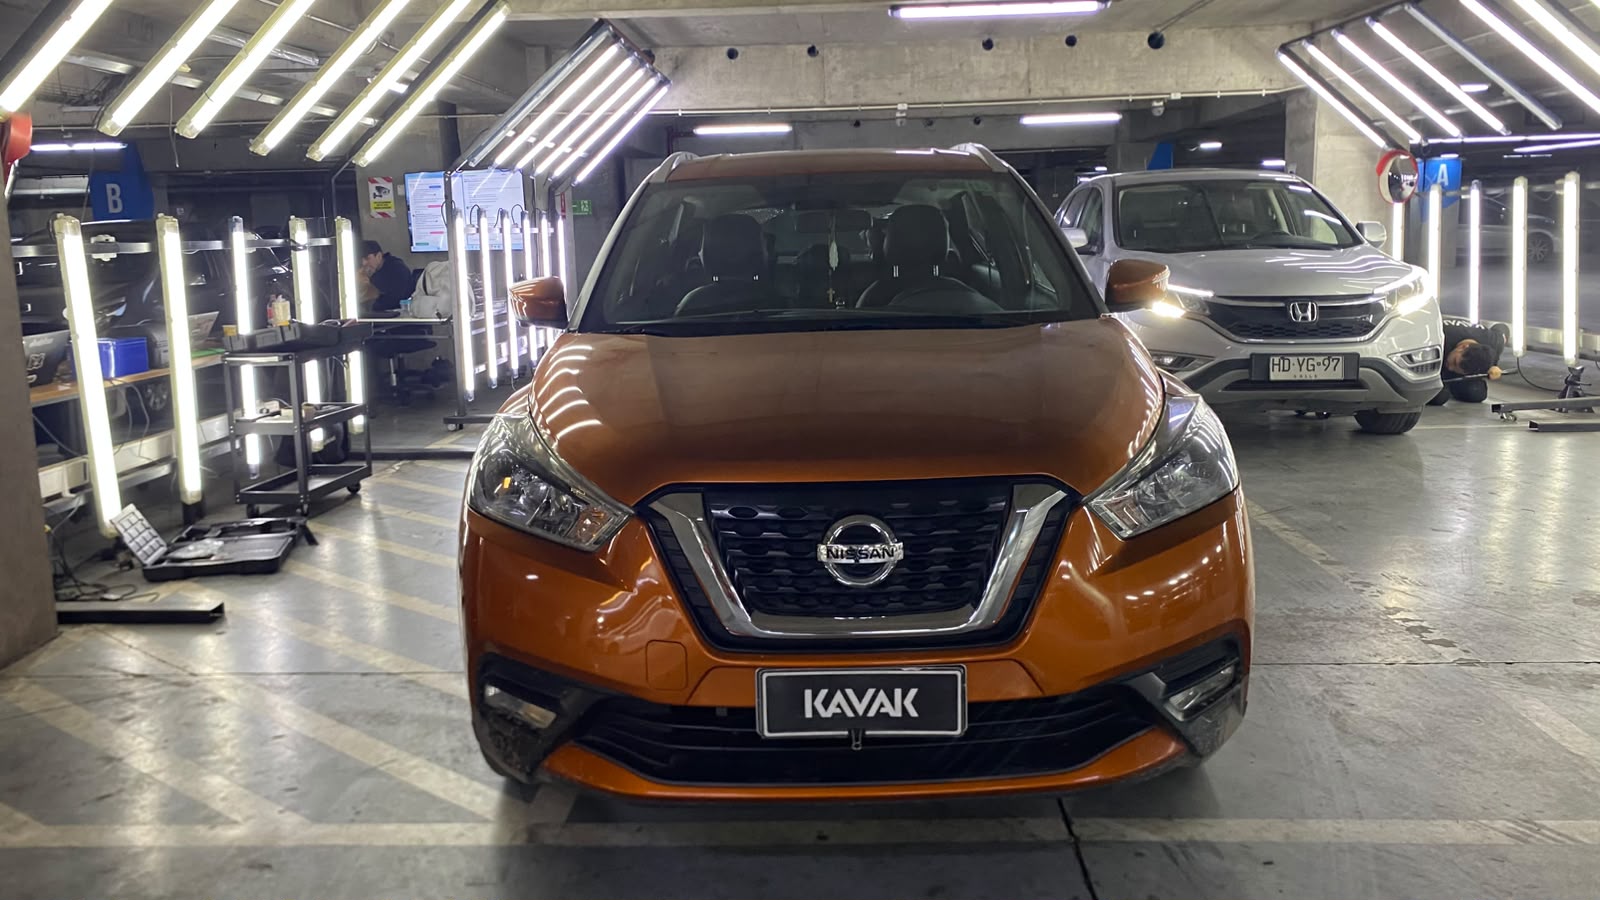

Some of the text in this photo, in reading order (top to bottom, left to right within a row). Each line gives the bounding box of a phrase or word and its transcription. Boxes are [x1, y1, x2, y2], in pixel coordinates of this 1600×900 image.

[1437, 163, 1449, 186] A
[106, 183, 123, 213] B
[826, 546, 895, 560] NISSAN
[804, 688, 920, 718] KAVAK
